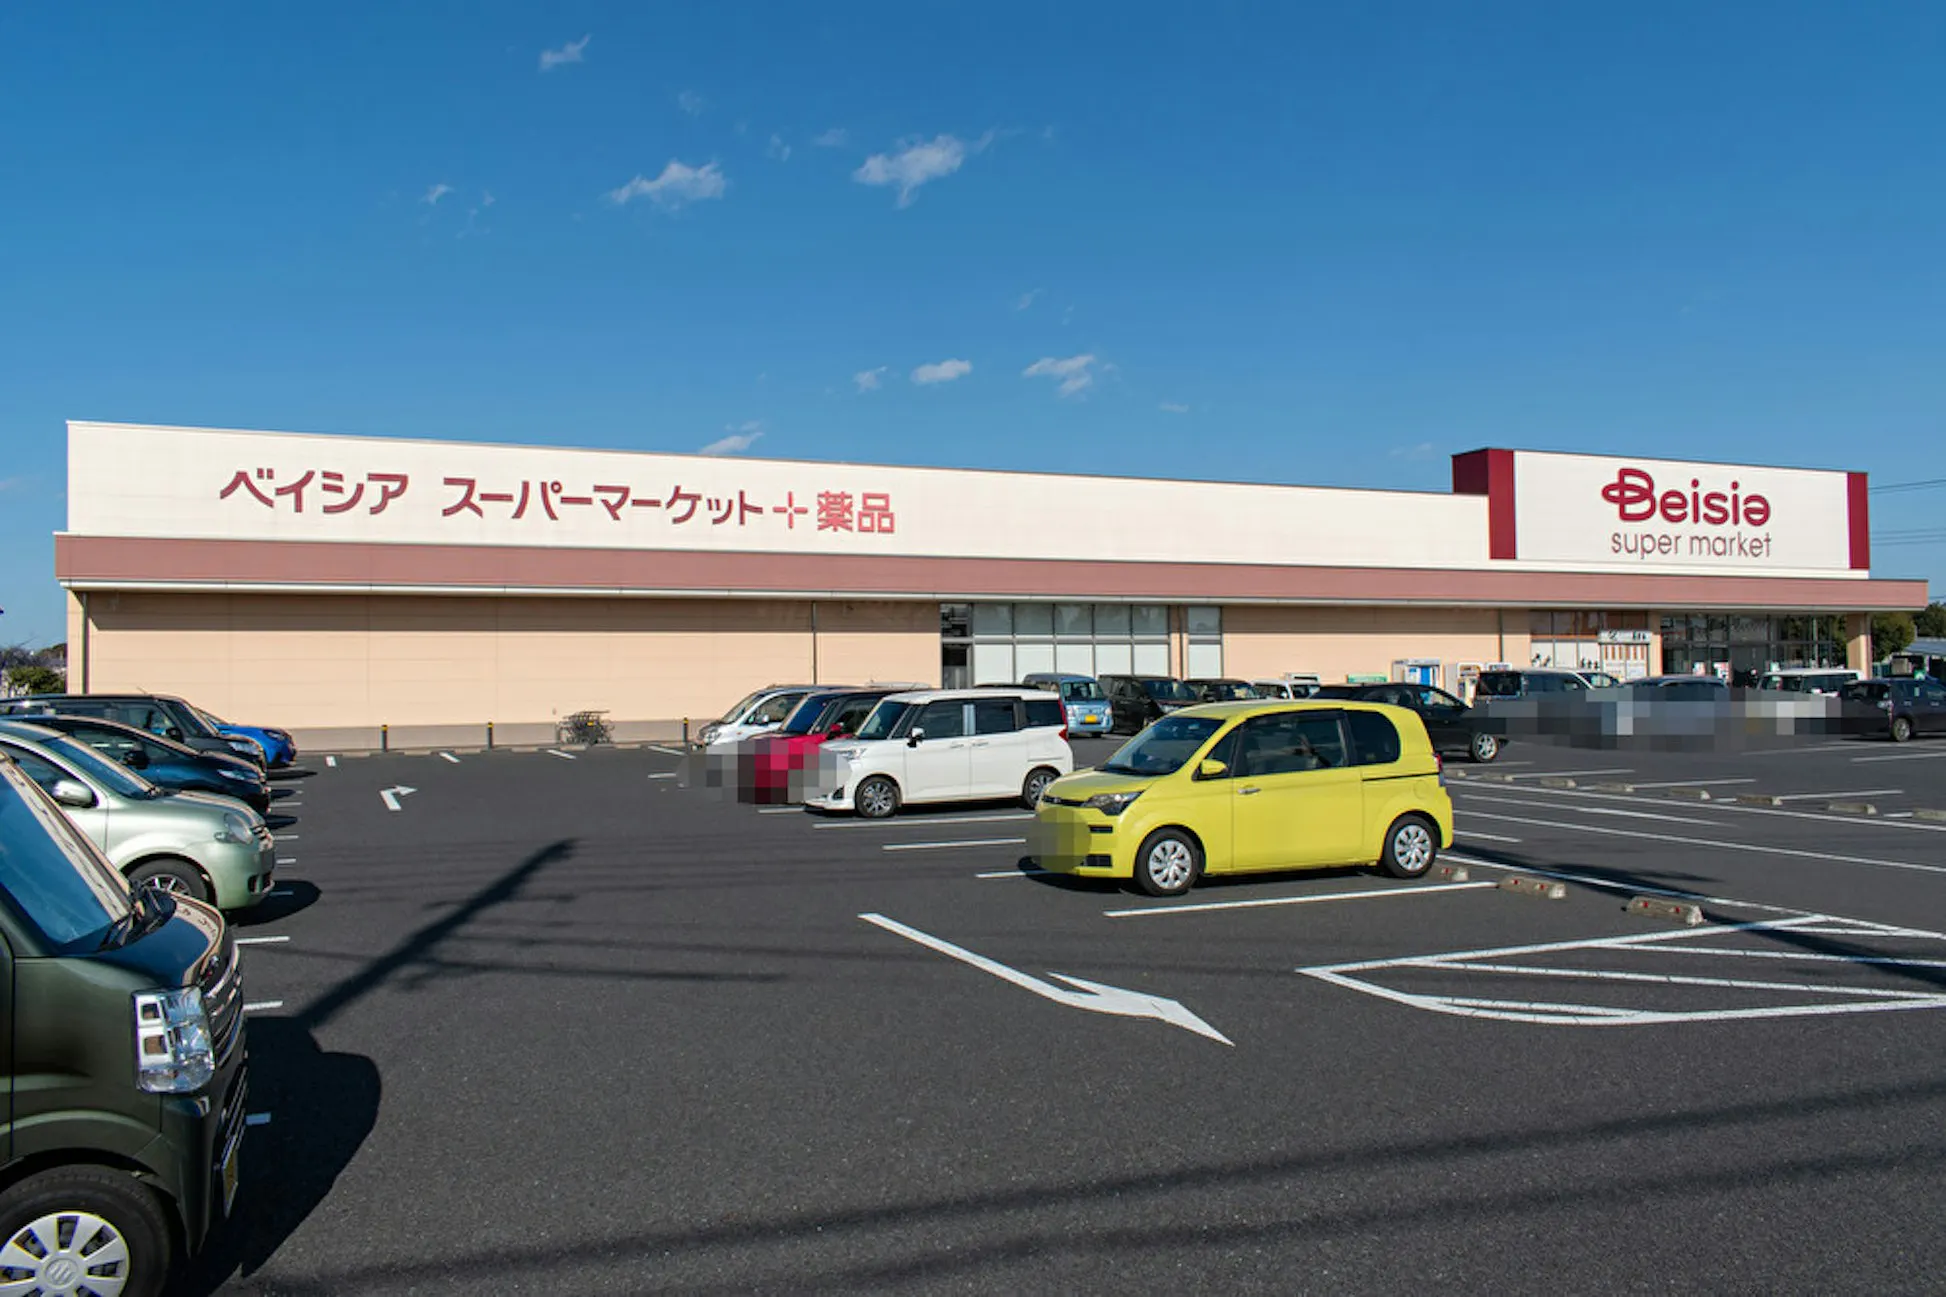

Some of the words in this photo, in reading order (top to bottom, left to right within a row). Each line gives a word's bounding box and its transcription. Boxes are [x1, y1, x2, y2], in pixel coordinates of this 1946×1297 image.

[221, 468, 409, 515] ベイシア
[1611, 531, 1681, 560] super
[1689, 531, 1772, 558] market
